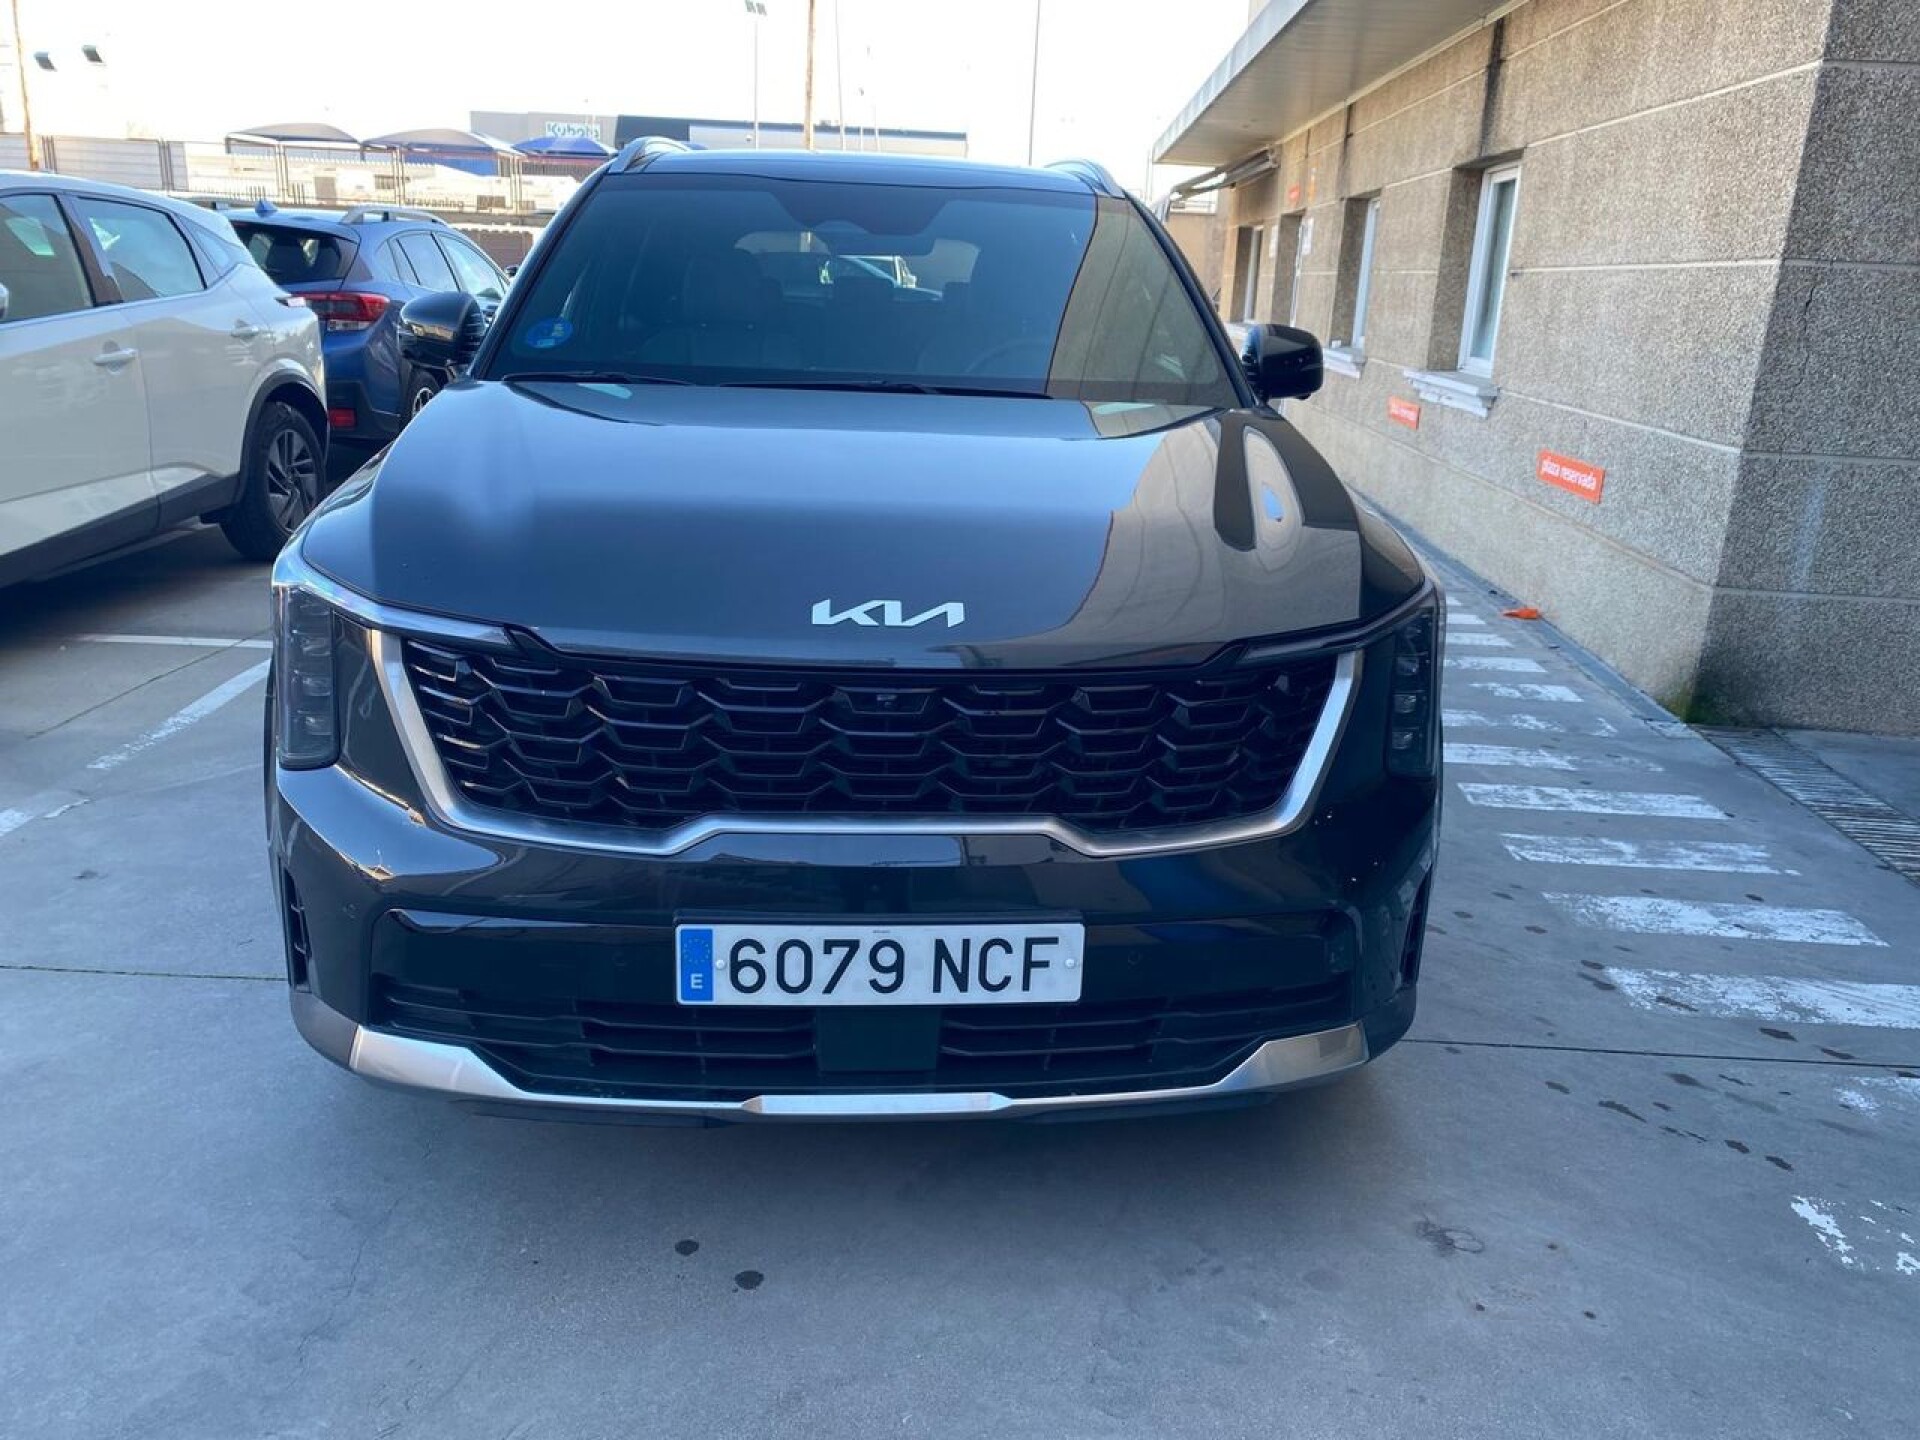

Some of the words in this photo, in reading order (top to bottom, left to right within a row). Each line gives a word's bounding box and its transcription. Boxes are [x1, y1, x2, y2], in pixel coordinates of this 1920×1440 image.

[546, 122, 600, 139] Kubota
[811, 599, 965, 627] KIA
[729, 938, 905, 994] 6079
[932, 936, 1060, 994] NCF
[690, 973, 703, 989] E
